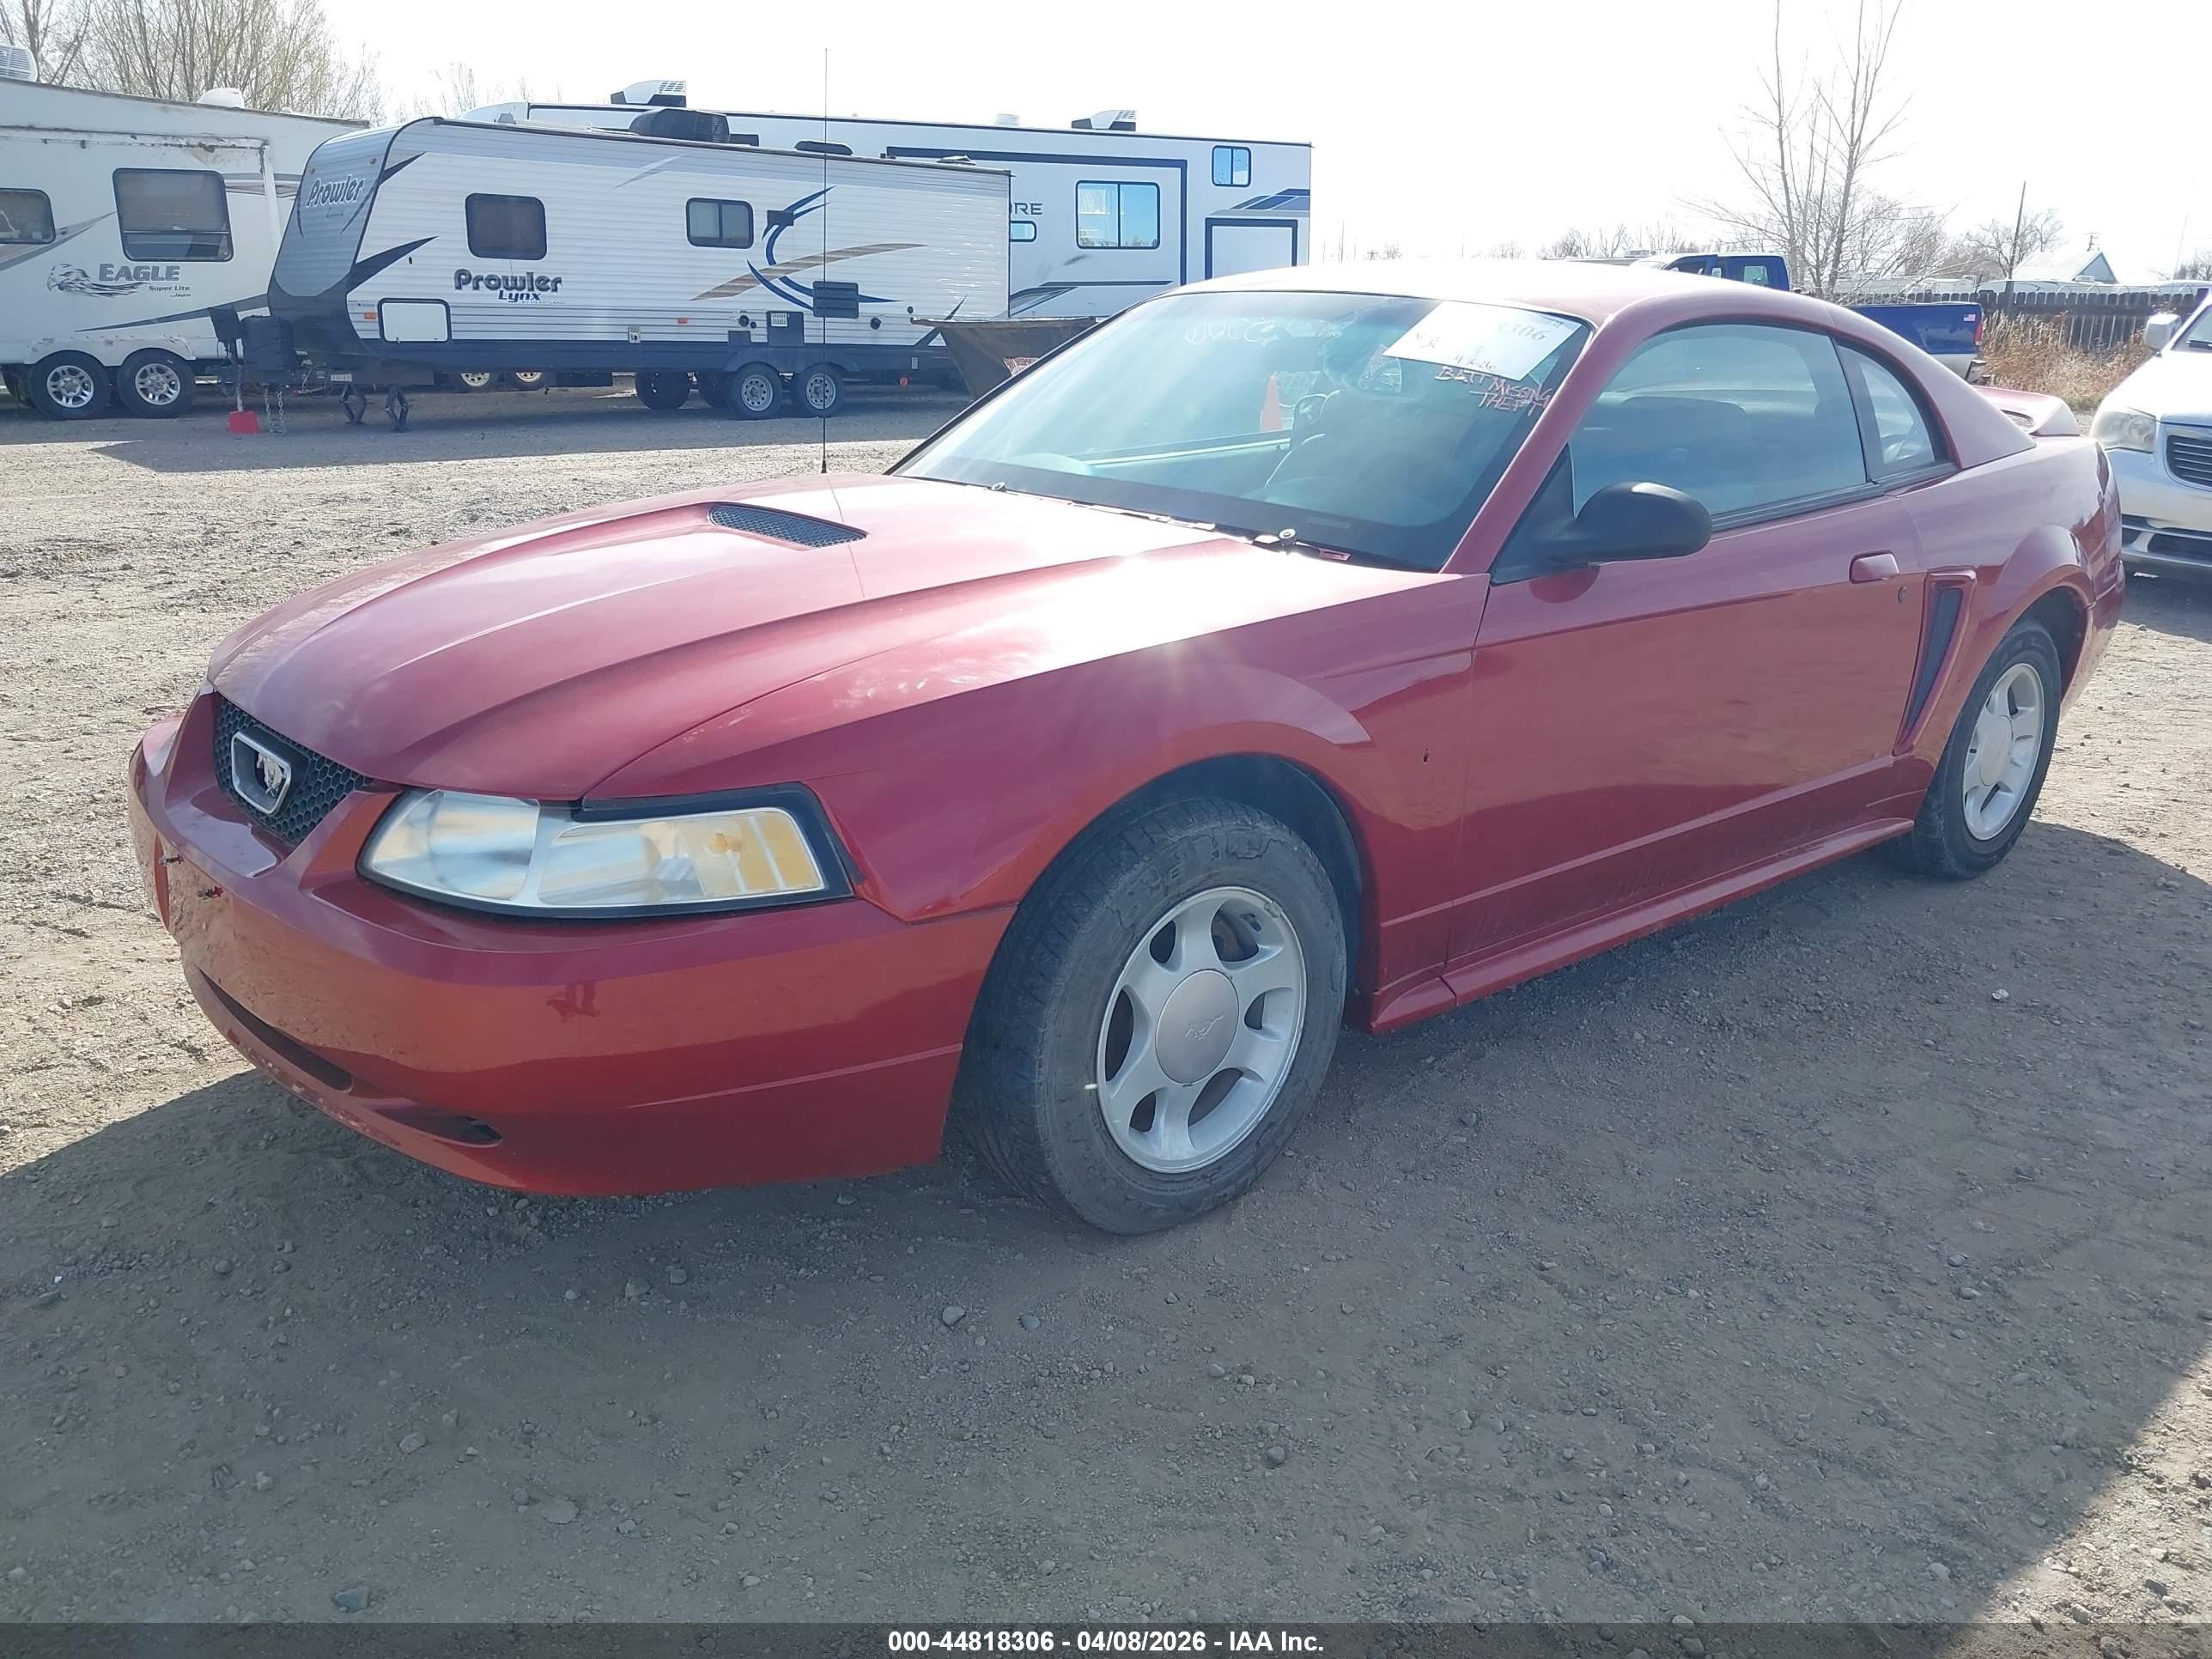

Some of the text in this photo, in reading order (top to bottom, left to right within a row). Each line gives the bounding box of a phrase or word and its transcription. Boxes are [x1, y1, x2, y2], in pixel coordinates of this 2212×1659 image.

[306, 173, 365, 207] Prowler
[99, 263, 180, 281] EAGLE
[454, 269, 562, 292] Prowler
[498, 290, 541, 302] Lynx
[1434, 365, 1553, 410] BATT MISSING
[1469, 391, 1543, 416] THEFT
